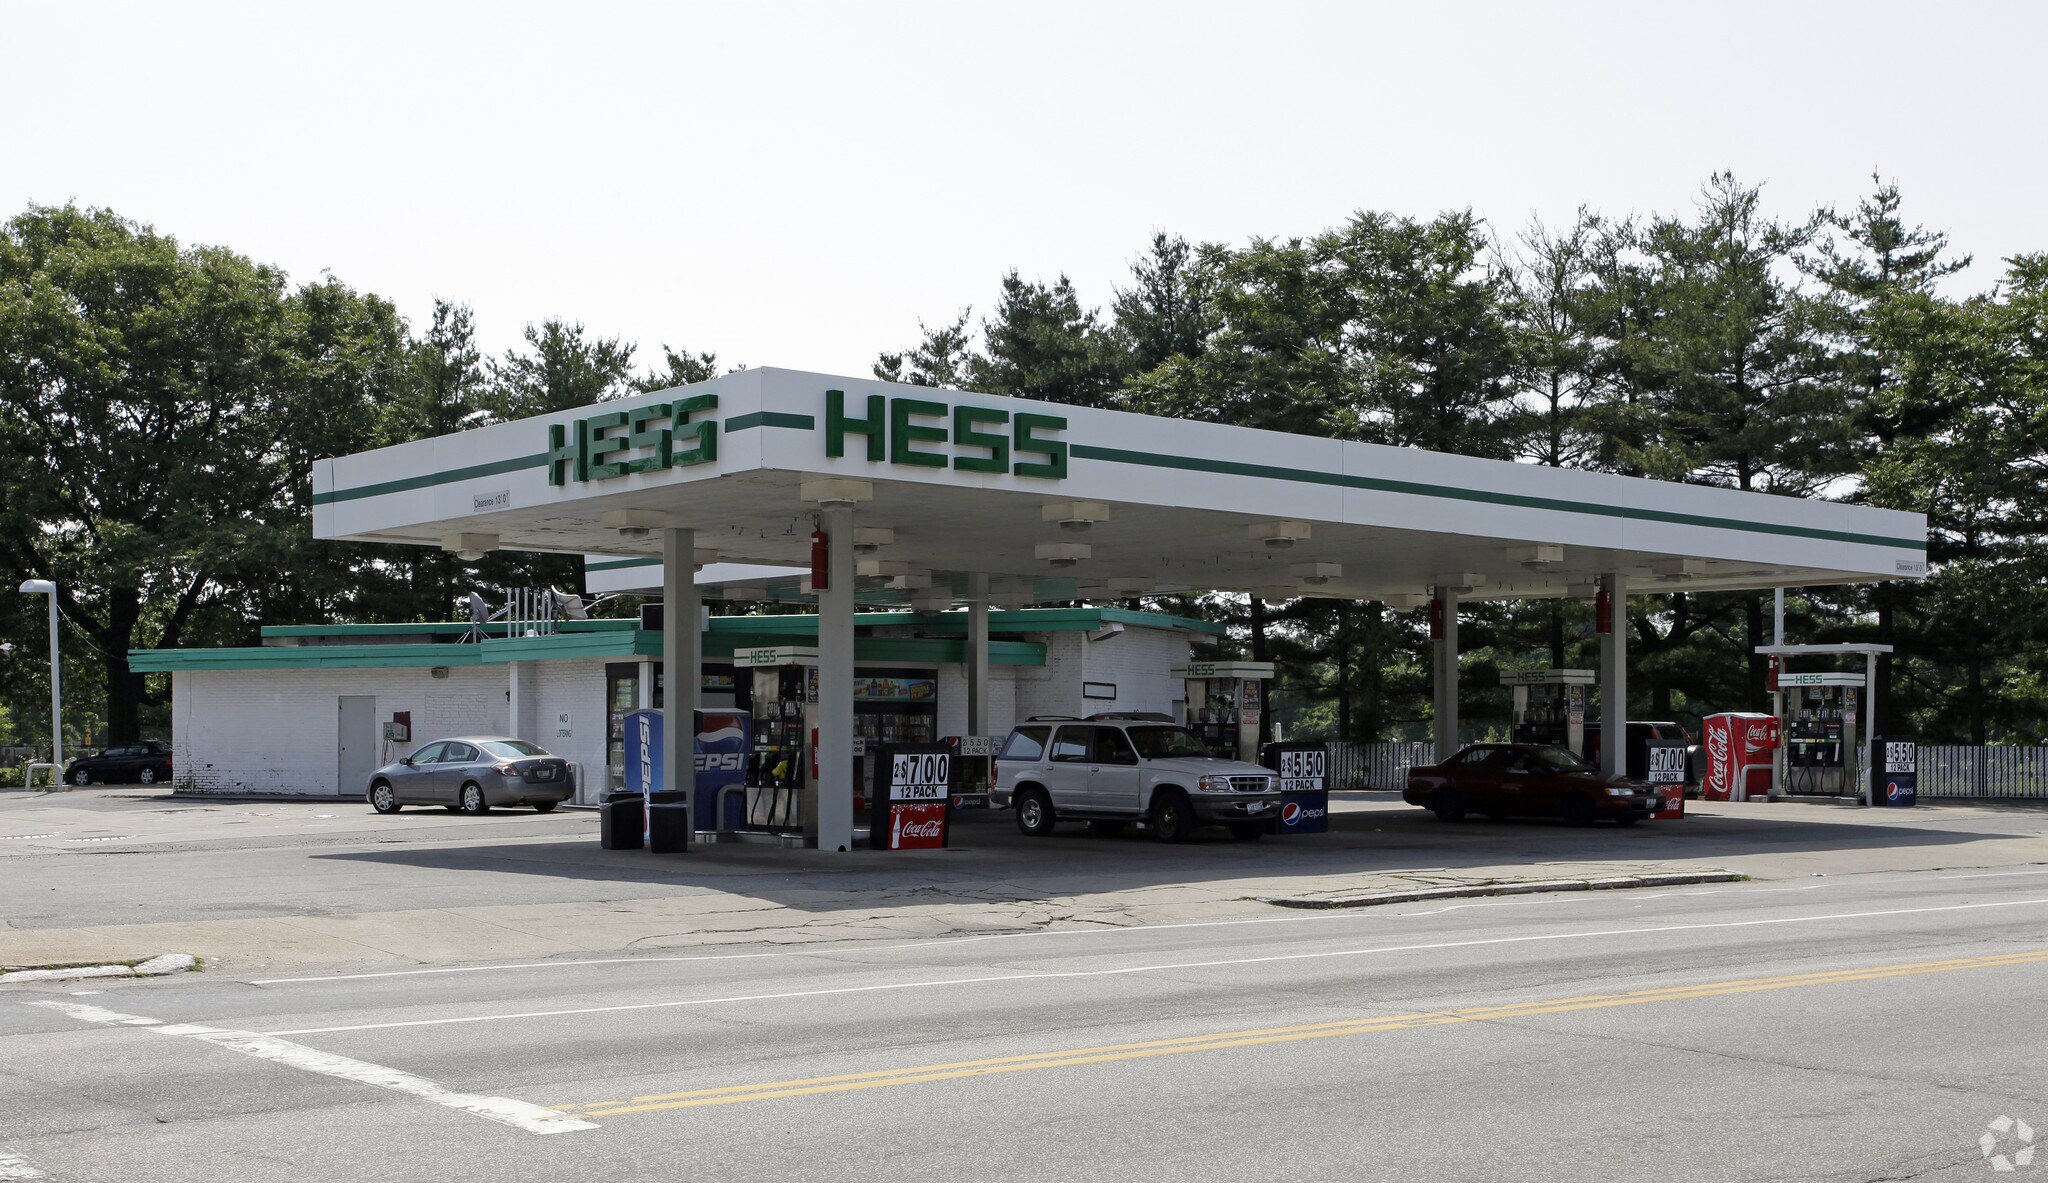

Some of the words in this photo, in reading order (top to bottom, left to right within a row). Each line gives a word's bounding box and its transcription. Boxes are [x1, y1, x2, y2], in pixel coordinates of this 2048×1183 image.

[549, 394, 718, 486] HESS
[826, 389, 1067, 479] HESS
[750, 650, 776, 663] HESS
[1187, 664, 1214, 676] HESS
[1517, 672, 1545, 682] HESS
[1795, 675, 1822, 684] HESS
[559, 713, 569, 723] NO
[639, 715, 652, 803] PEPSI
[694, 752, 744, 771] EPSI
[1709, 723, 1728, 793] Coca-Cola
[1891, 764, 1896, 772] 12
[1655, 773, 1661, 781] 12
[1663, 772, 1678, 781] PACK
[1285, 781, 1293, 790] 12
[1295, 780, 1315, 790] PACK
[900, 787, 911, 798] 12
[914, 787, 937, 797] PACK
[1301, 807, 1325, 819] pepsi
